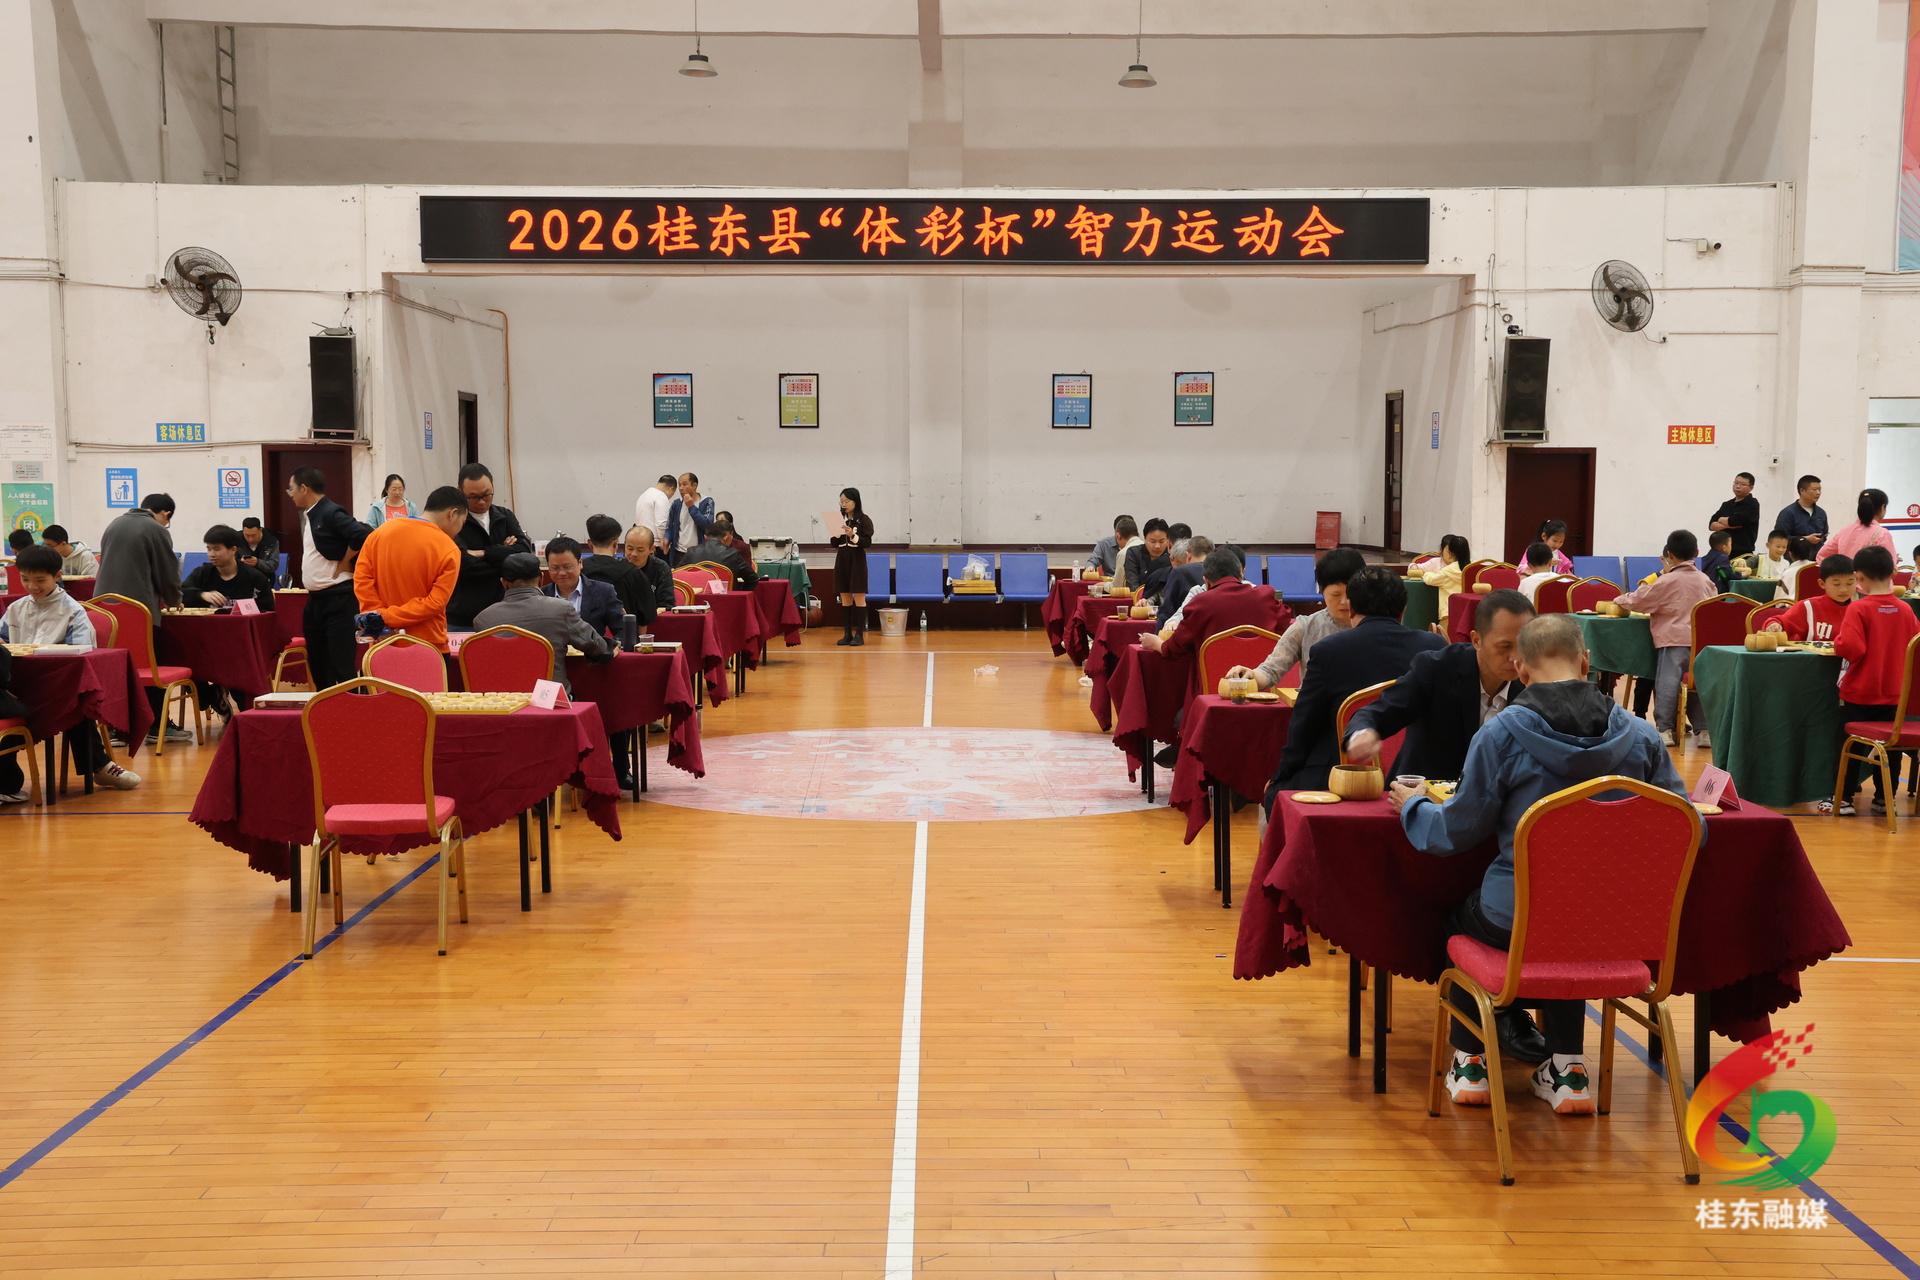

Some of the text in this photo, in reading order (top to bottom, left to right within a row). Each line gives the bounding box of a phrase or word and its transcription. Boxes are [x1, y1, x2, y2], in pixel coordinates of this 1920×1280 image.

[507, 204, 1345, 258] 2026桂东县“体彩杯”智力运动会
[159, 424, 203, 442] 客场休息区
[1671, 426, 1712, 443] 主场休息区
